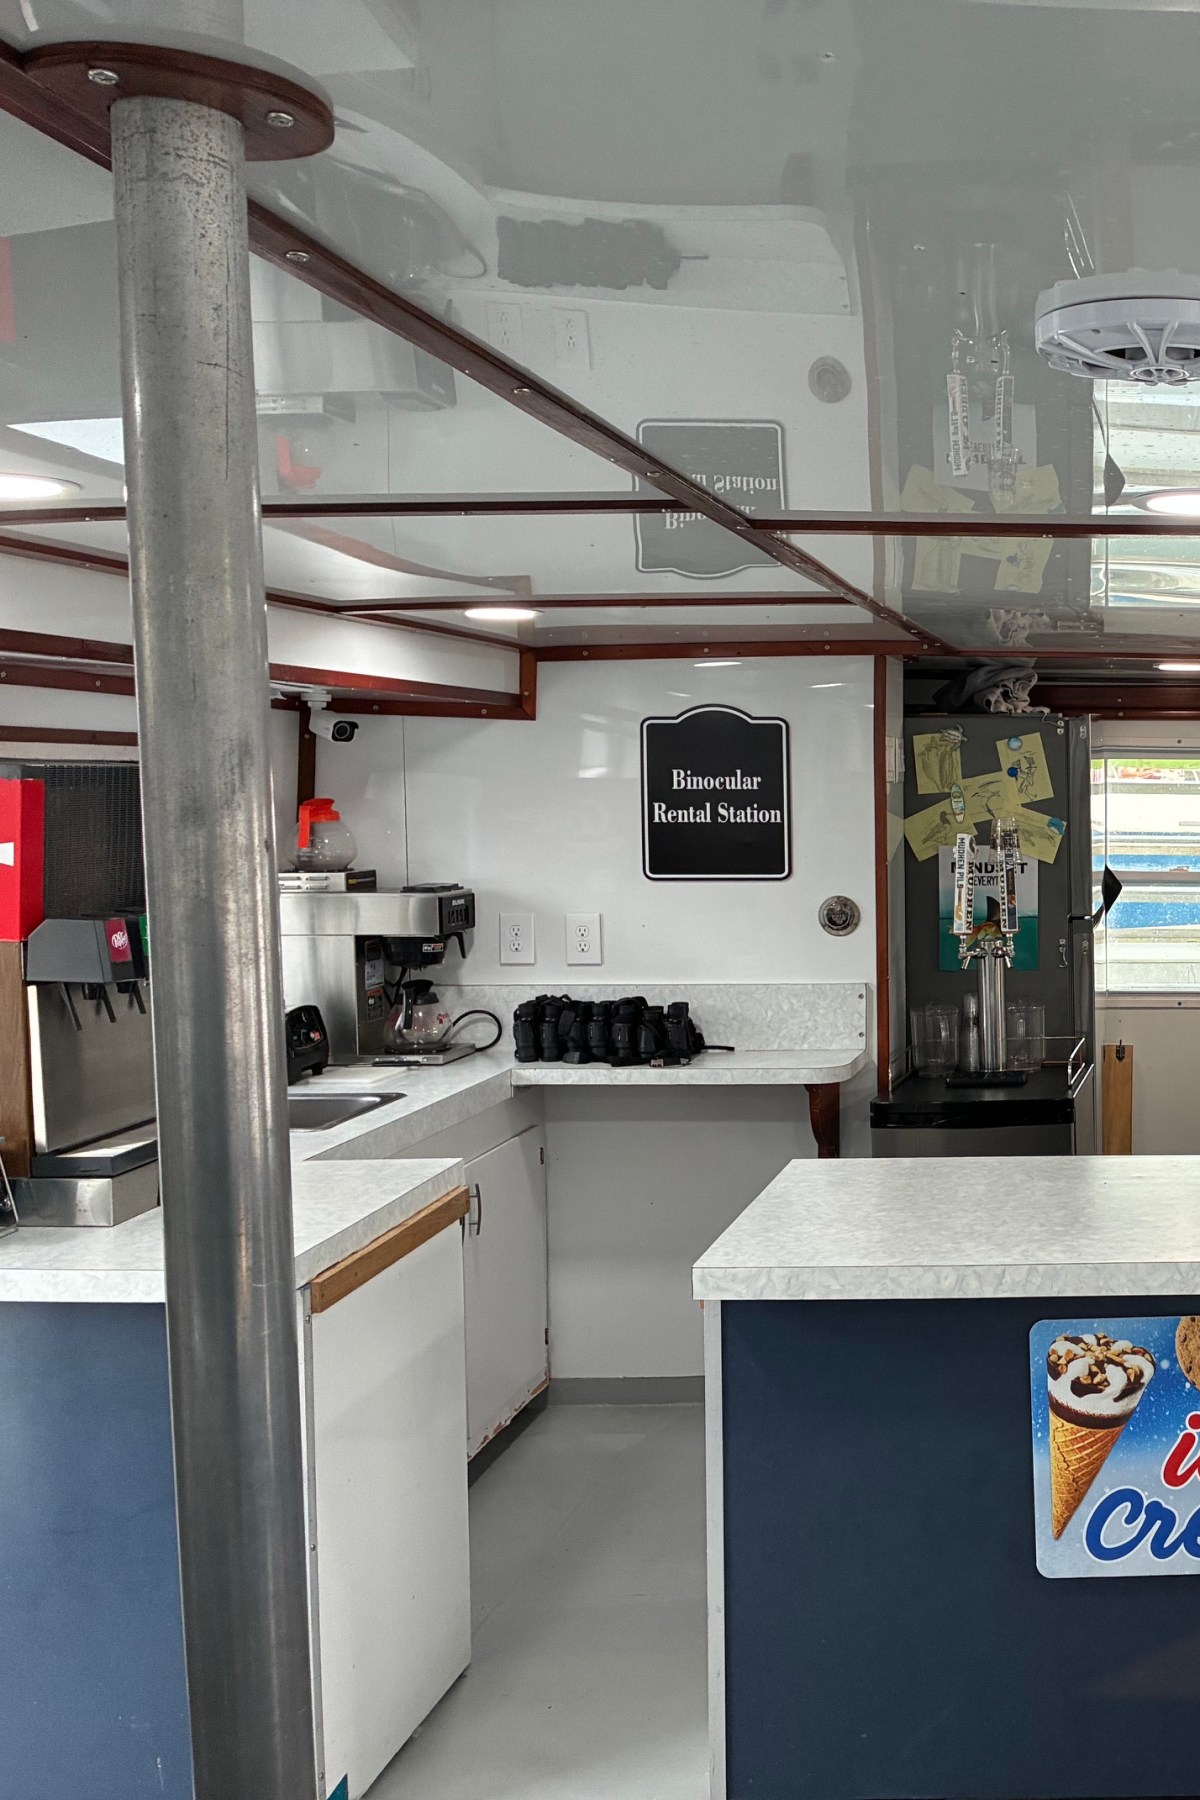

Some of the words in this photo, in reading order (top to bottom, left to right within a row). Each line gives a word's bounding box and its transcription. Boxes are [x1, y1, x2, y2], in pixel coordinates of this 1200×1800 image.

[672, 769, 762, 790] Binocular
[653, 802, 712, 823] Rental
[718, 802, 782, 823] Station
[957, 837, 965, 870] MUDHEN
[966, 861, 975, 931] MUDHEN
